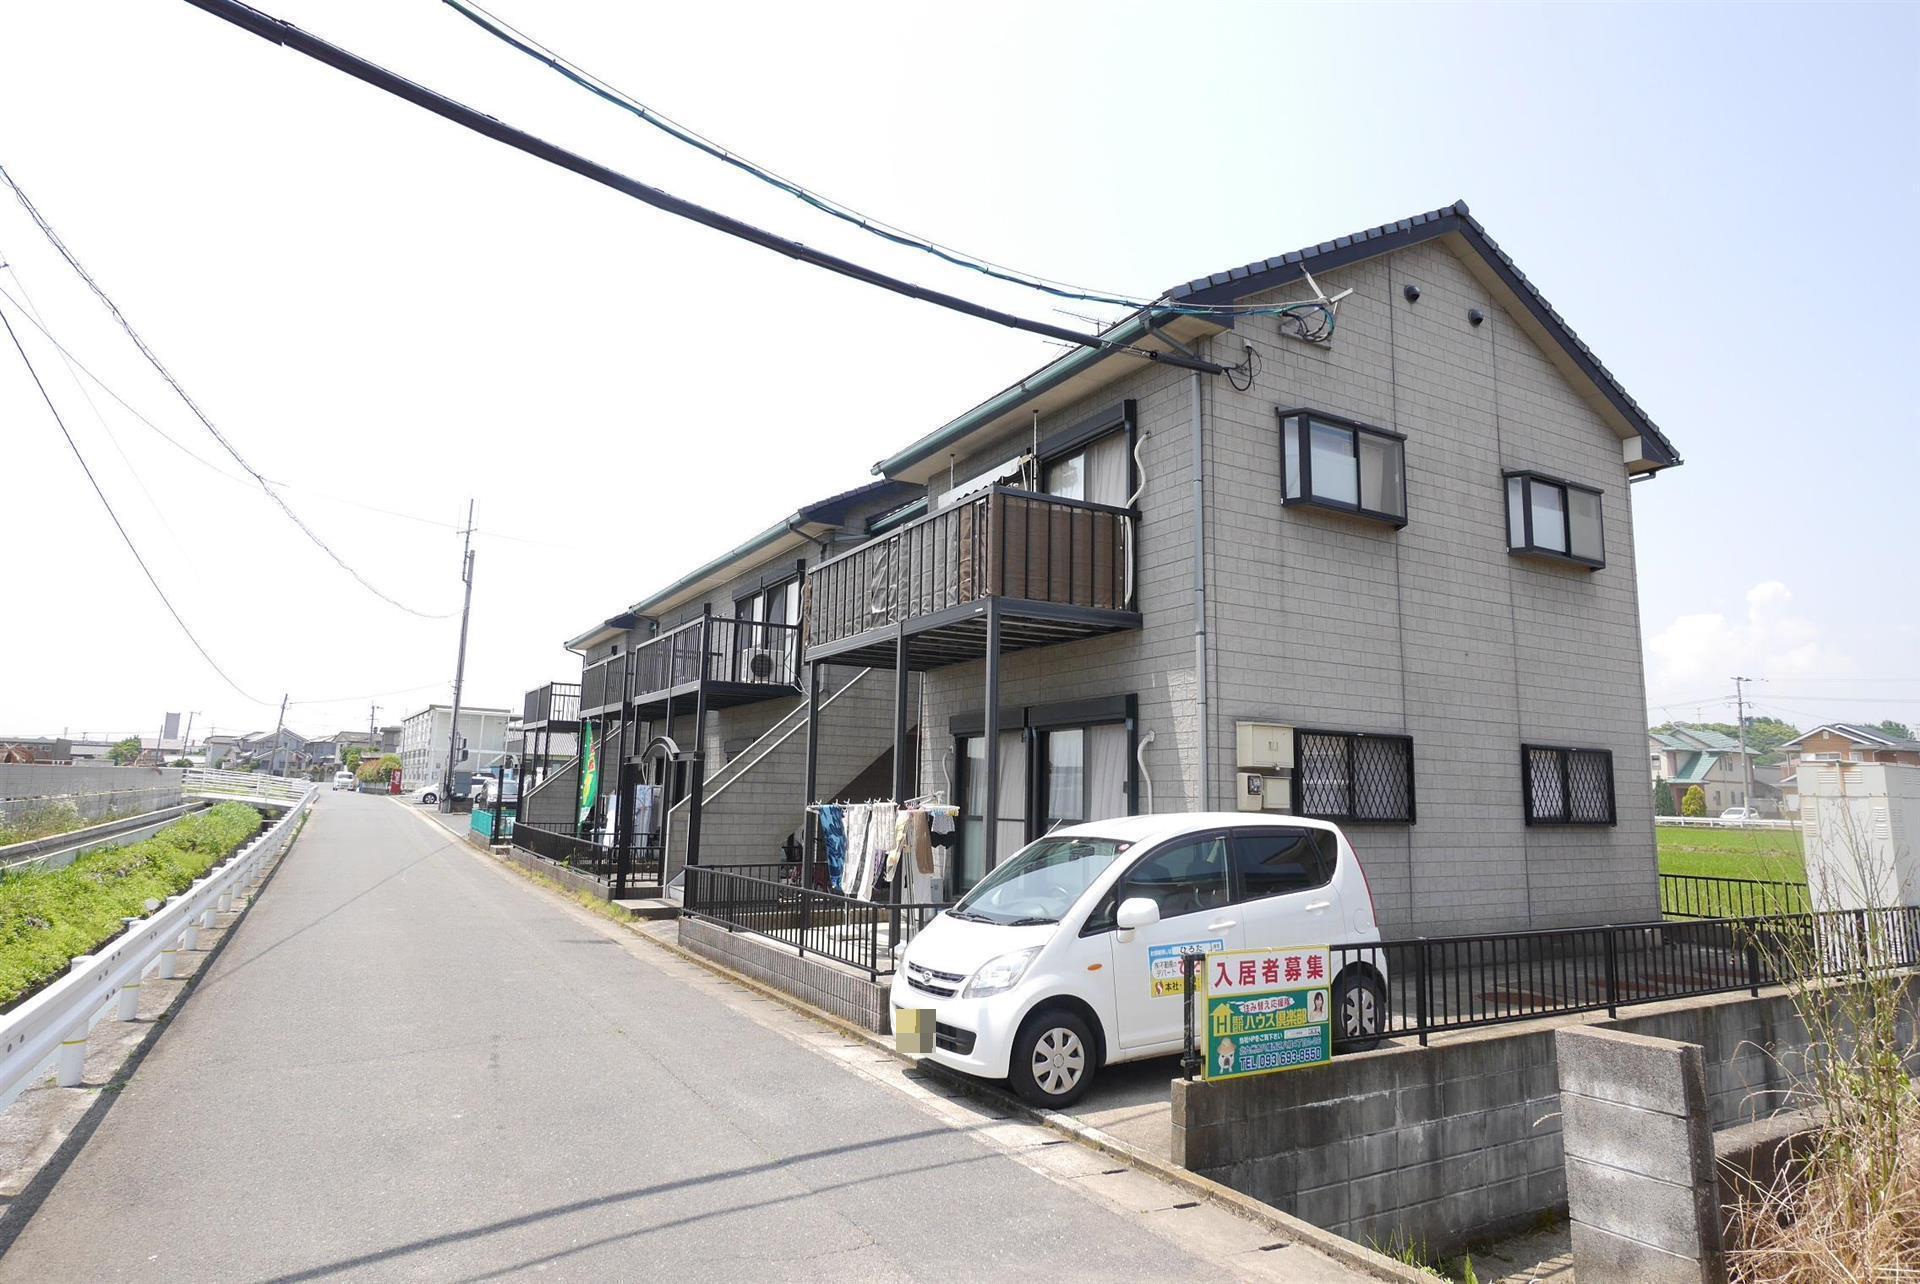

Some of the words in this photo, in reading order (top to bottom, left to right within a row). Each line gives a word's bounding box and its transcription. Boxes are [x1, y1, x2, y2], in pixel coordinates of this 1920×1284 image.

[1214, 954, 1323, 988] 入居者募集
[1244, 1008, 1307, 1030] ハウス倶楽部
